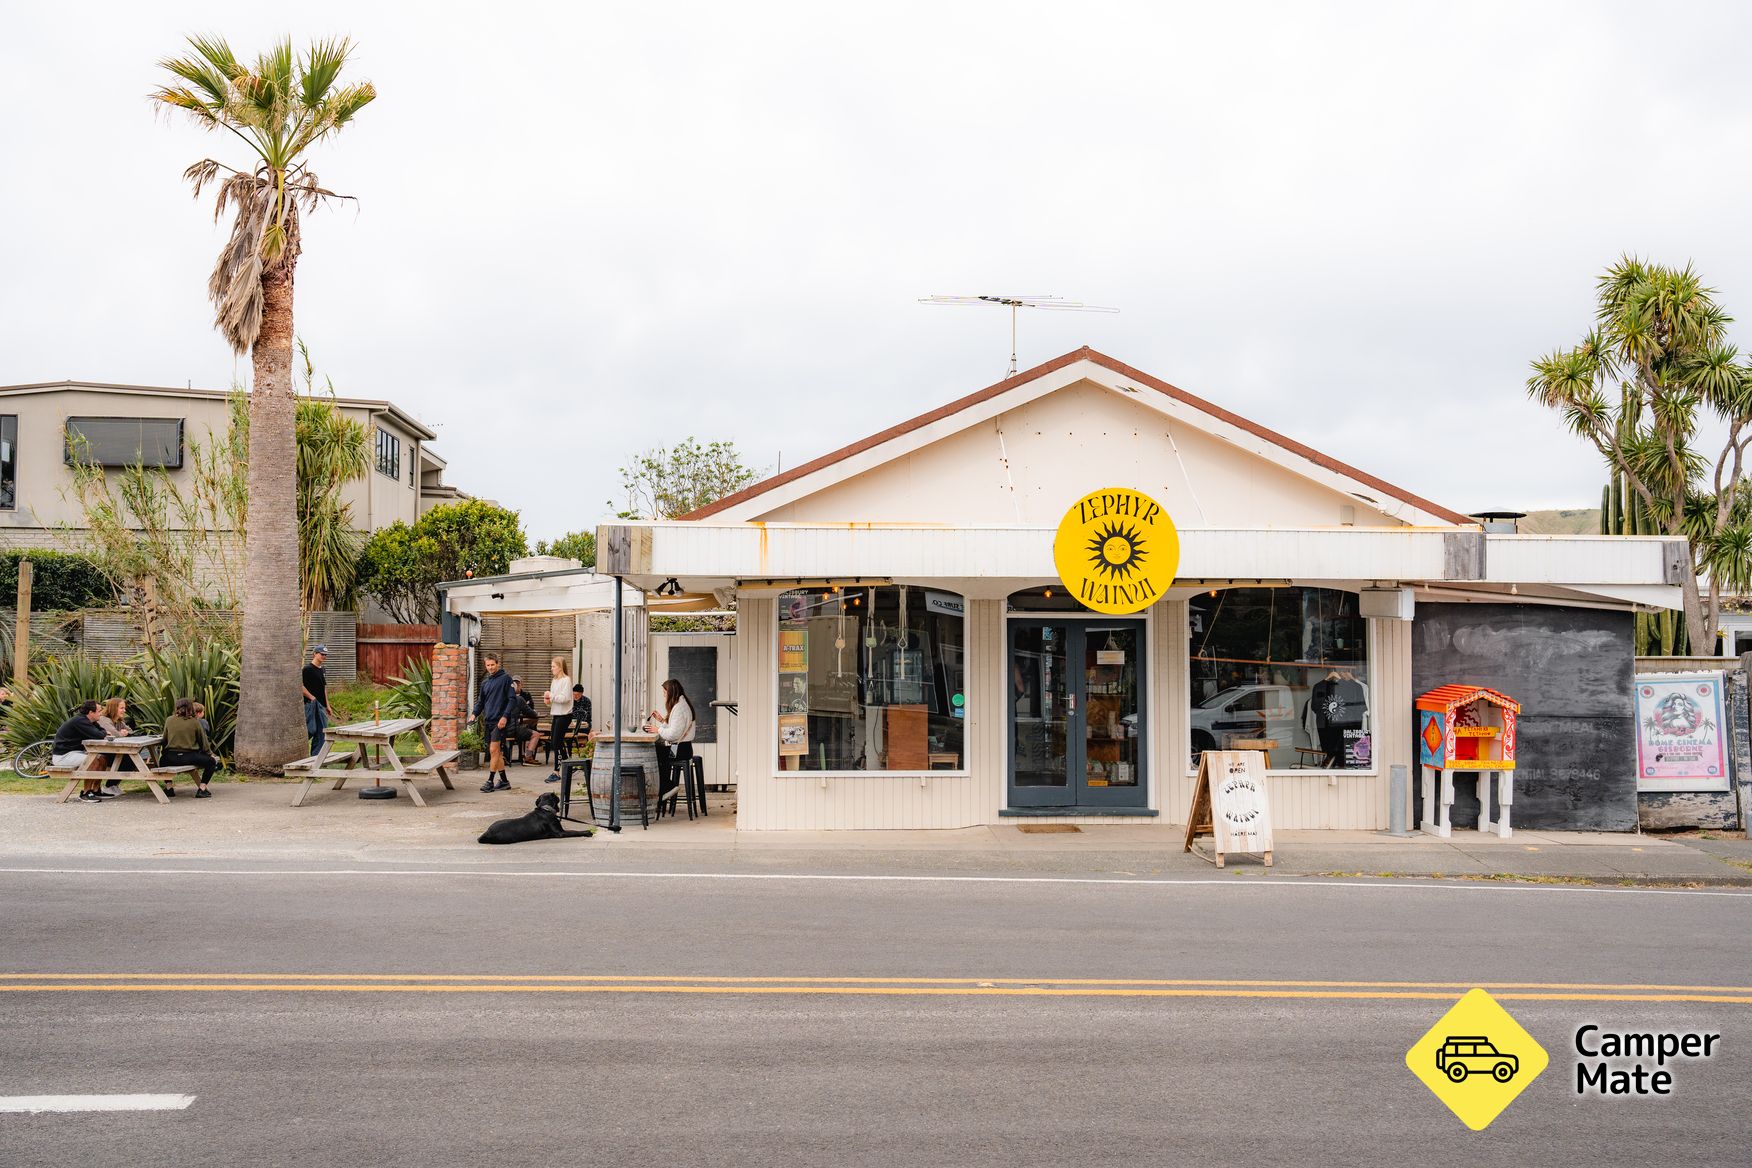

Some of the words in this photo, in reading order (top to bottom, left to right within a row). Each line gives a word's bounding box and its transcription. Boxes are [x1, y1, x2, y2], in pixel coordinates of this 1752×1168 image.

[1073, 494, 1160, 526] ZEPHYR
[1080, 577, 1157, 605] WAINUI
[1657, 745, 1703, 753] GISBORNE
[1677, 738, 1713, 746] CINEMA
